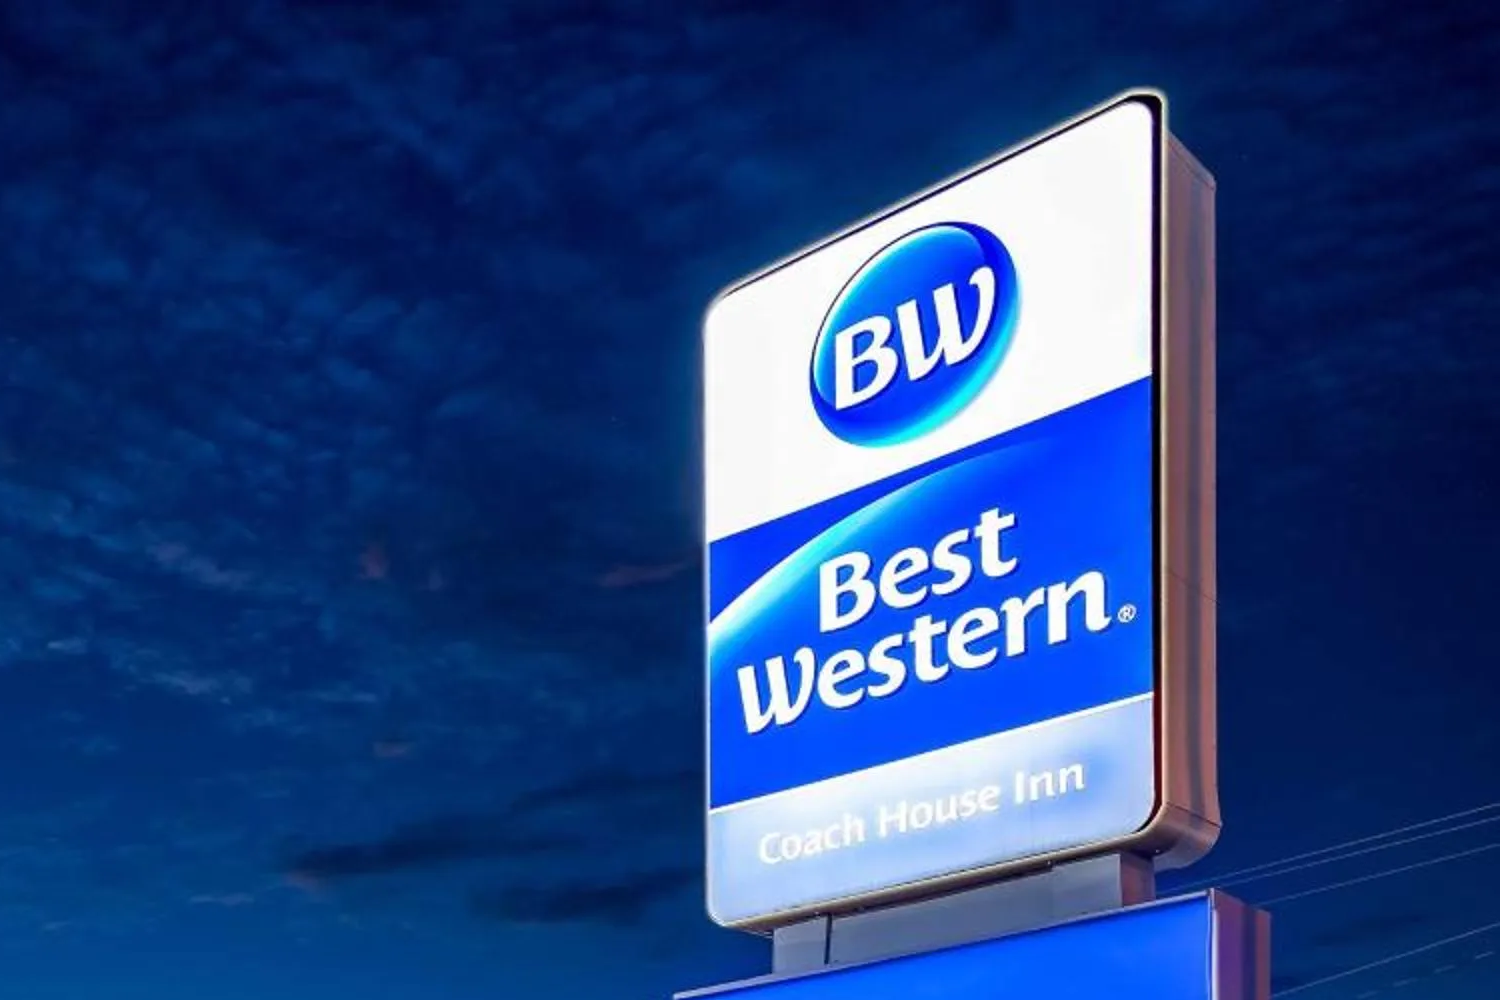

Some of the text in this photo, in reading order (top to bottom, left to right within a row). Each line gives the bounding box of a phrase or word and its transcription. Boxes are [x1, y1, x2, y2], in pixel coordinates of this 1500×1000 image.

[835, 266, 996, 411] BW
[819, 507, 1018, 633] Best
[758, 763, 1086, 864] Coach House Inn
